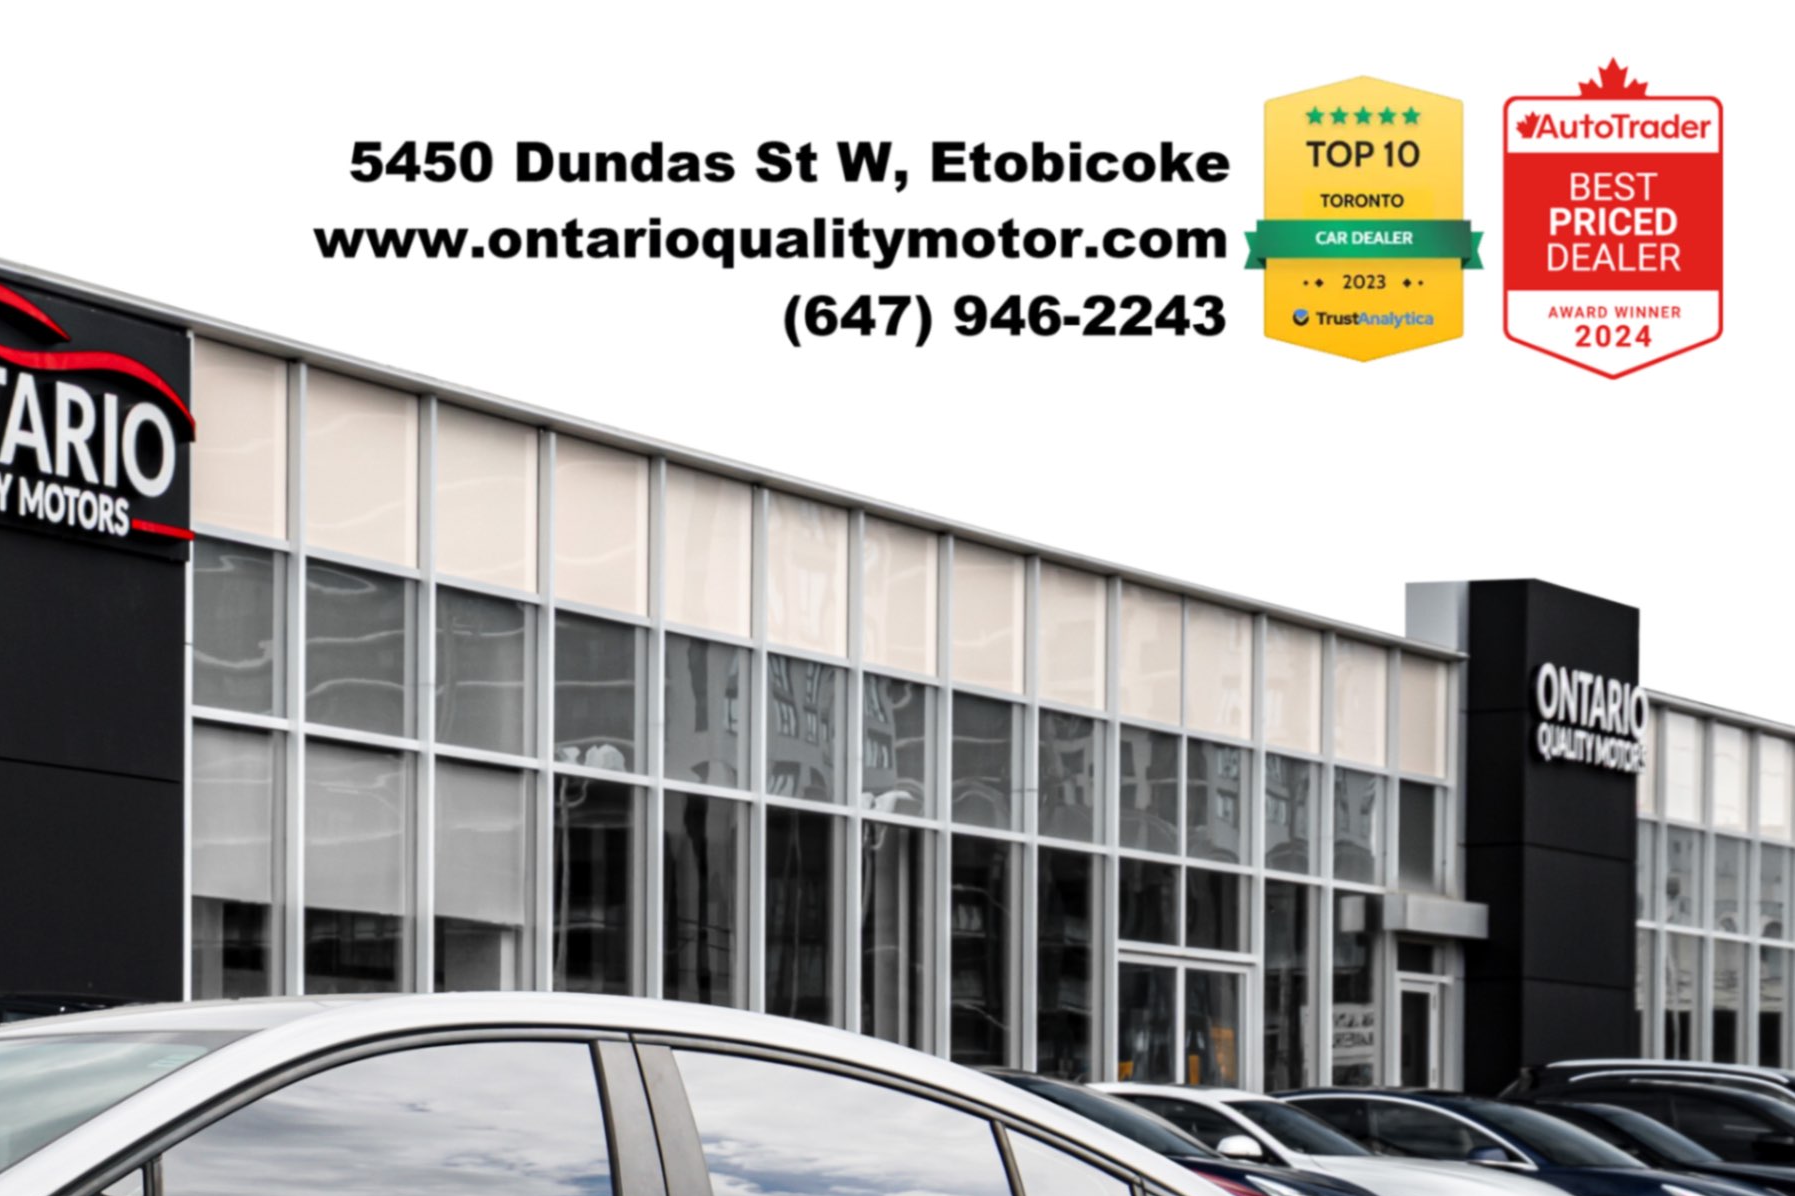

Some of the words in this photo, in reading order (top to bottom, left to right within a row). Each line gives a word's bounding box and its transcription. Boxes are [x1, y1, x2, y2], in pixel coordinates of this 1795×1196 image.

[18, 476, 131, 537] MOTORS
[1536, 662, 1649, 740] ONTARIO
[1537, 721, 1595, 764] QUALITY
[1593, 734, 1647, 774] MOTORS
